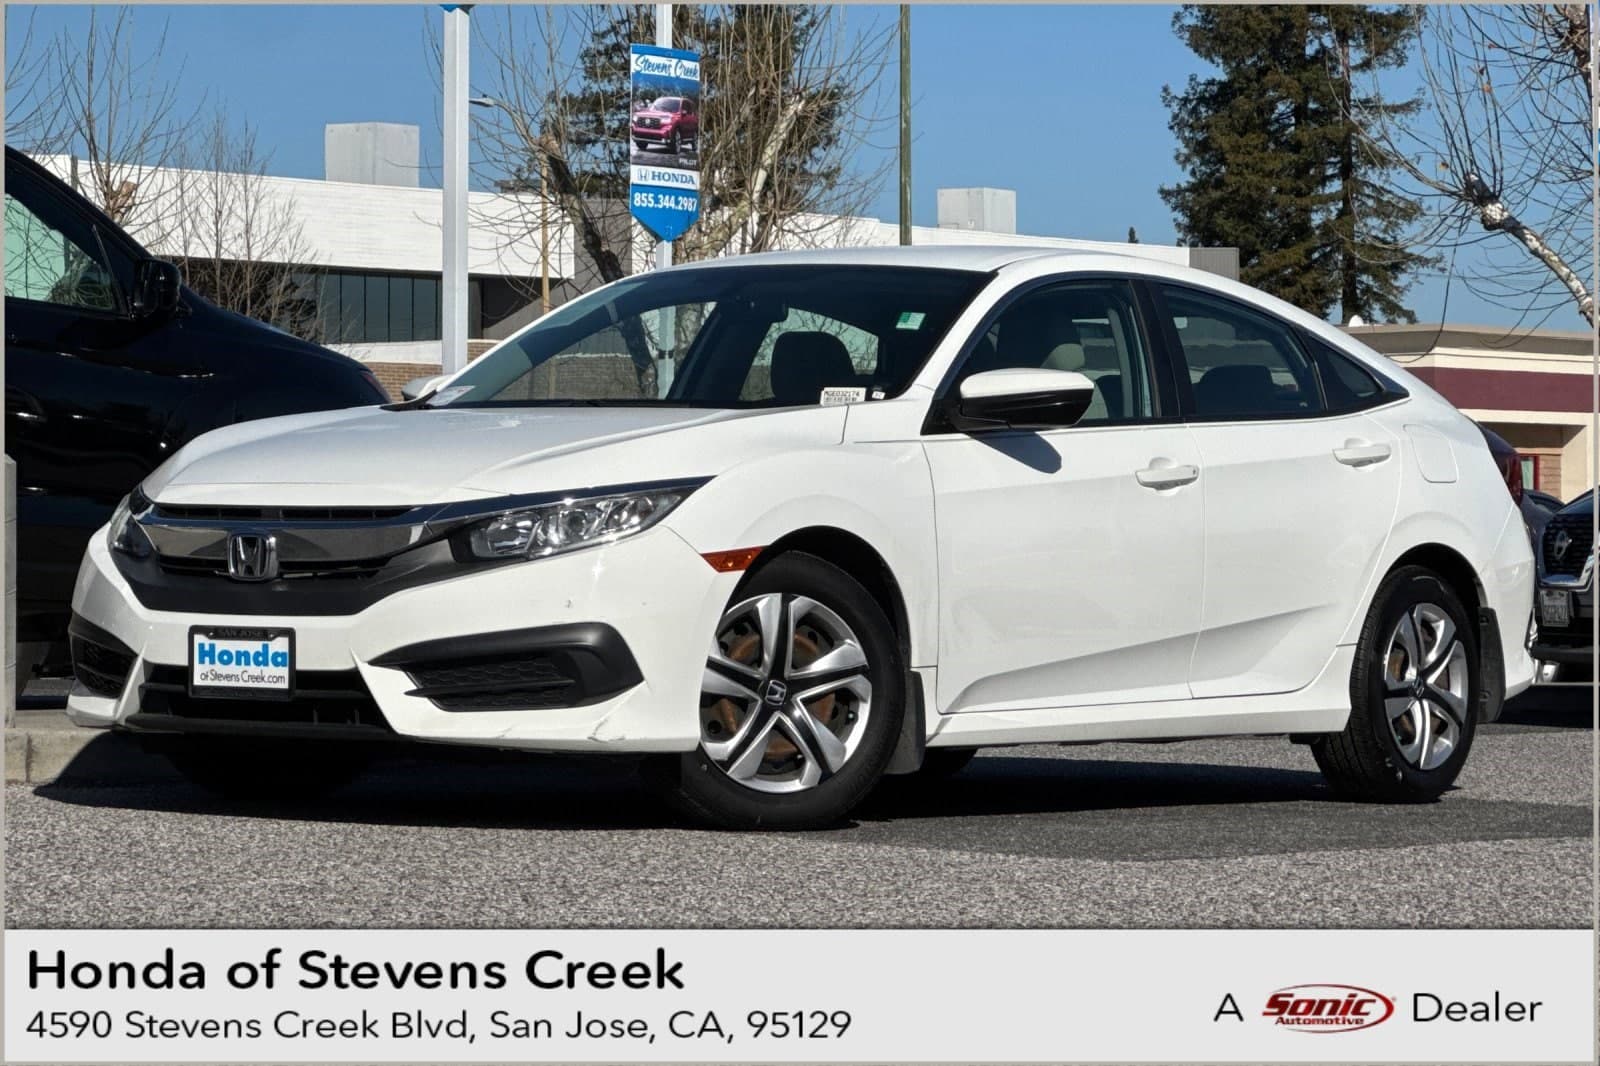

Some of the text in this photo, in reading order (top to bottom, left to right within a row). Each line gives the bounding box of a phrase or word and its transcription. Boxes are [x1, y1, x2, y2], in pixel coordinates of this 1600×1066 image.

[634, 54, 698, 78] Stevens Creek
[651, 170, 696, 185] HONDA
[633, 192, 698, 212] 855.344.2987
[198, 642, 288, 667] Honda
